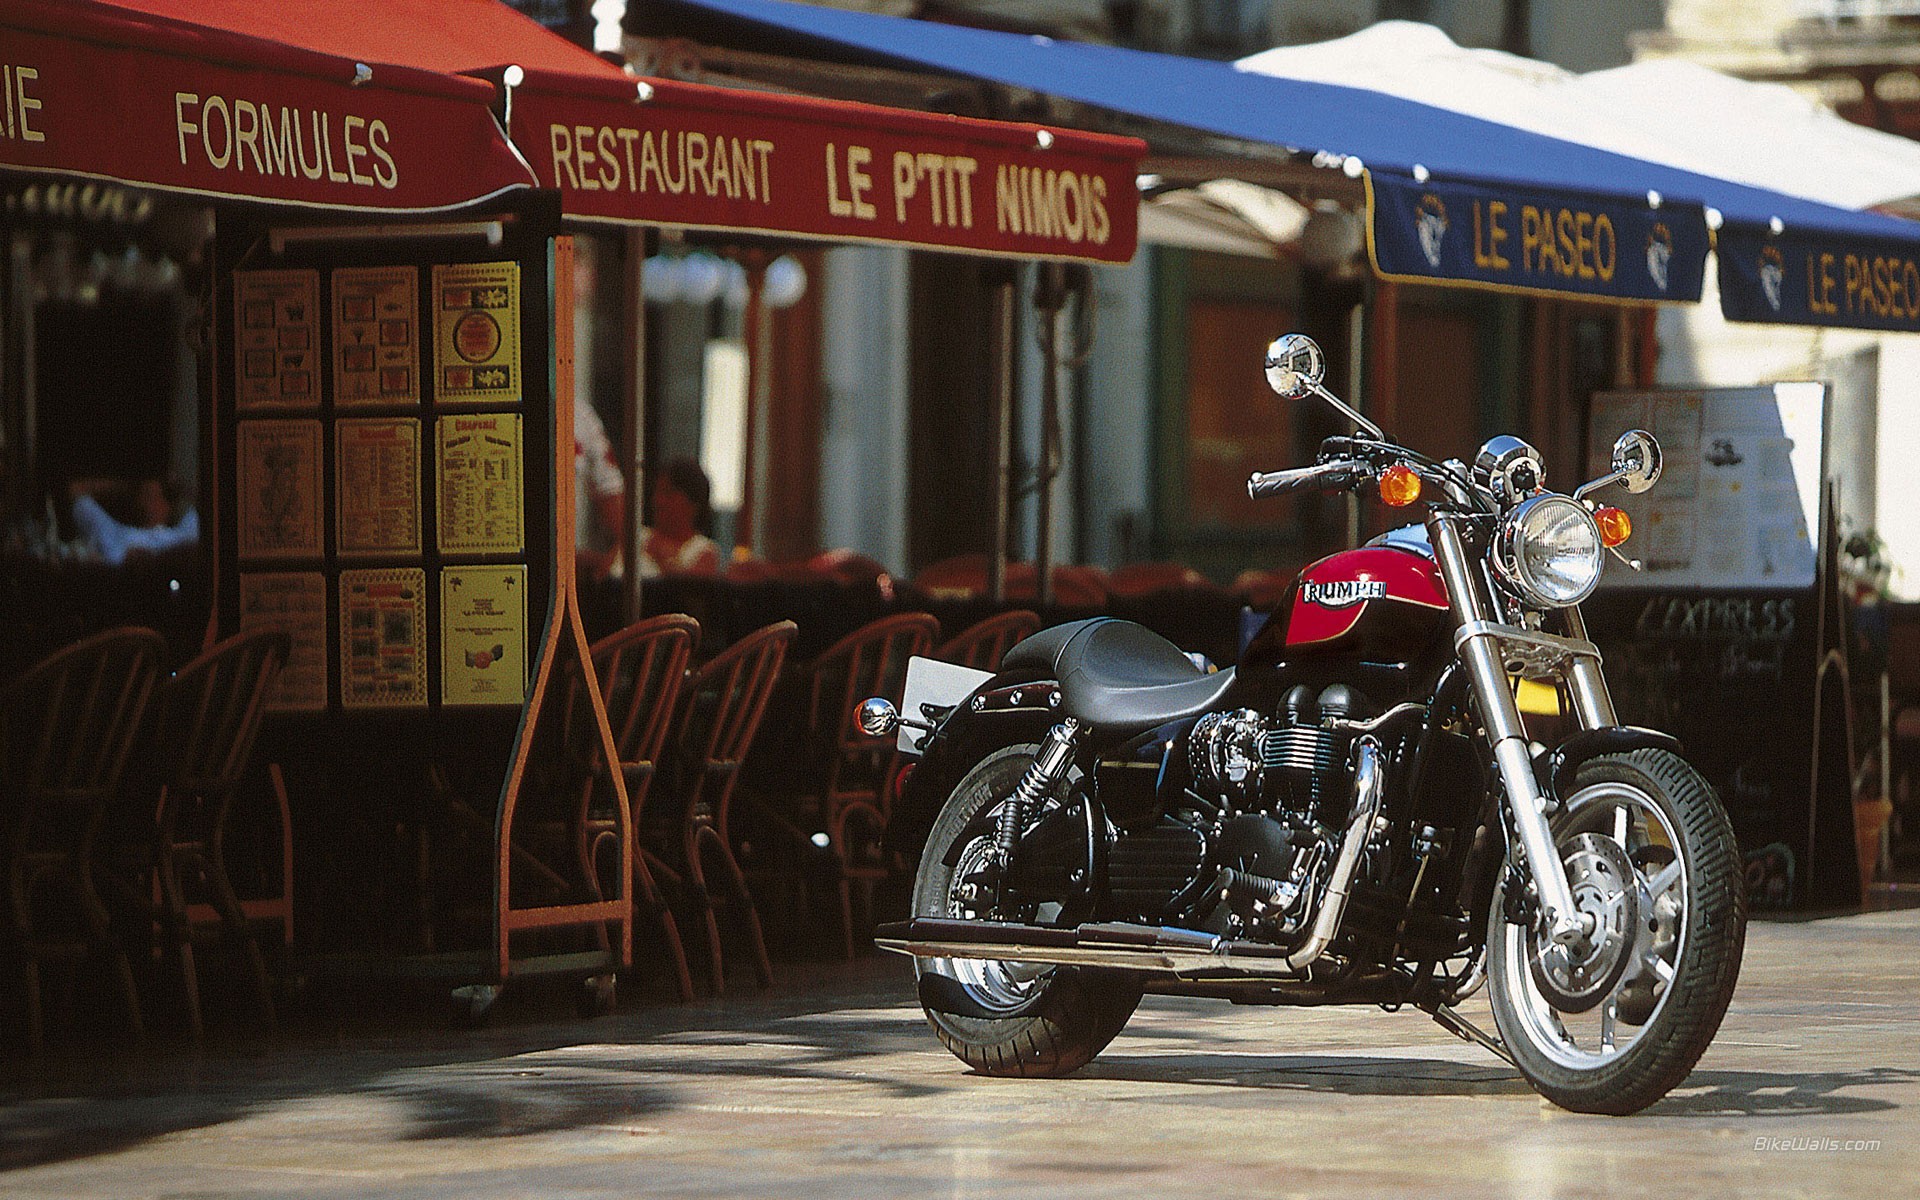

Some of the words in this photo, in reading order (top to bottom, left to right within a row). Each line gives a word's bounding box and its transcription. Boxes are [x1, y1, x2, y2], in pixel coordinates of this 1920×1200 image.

[0, 64, 46, 143] IE
[174, 92, 399, 190] FORMULES
[550, 123, 775, 204] RESTAURANT
[826, 142, 877, 221] LE
[893, 150, 978, 229] P'TIT
[996, 164, 1111, 246] NIMOIS
[1472, 199, 1511, 270] LE
[1522, 205, 1617, 282] PASEO
[1806, 251, 1838, 316] LE
[1844, 253, 1920, 320] PASEO
